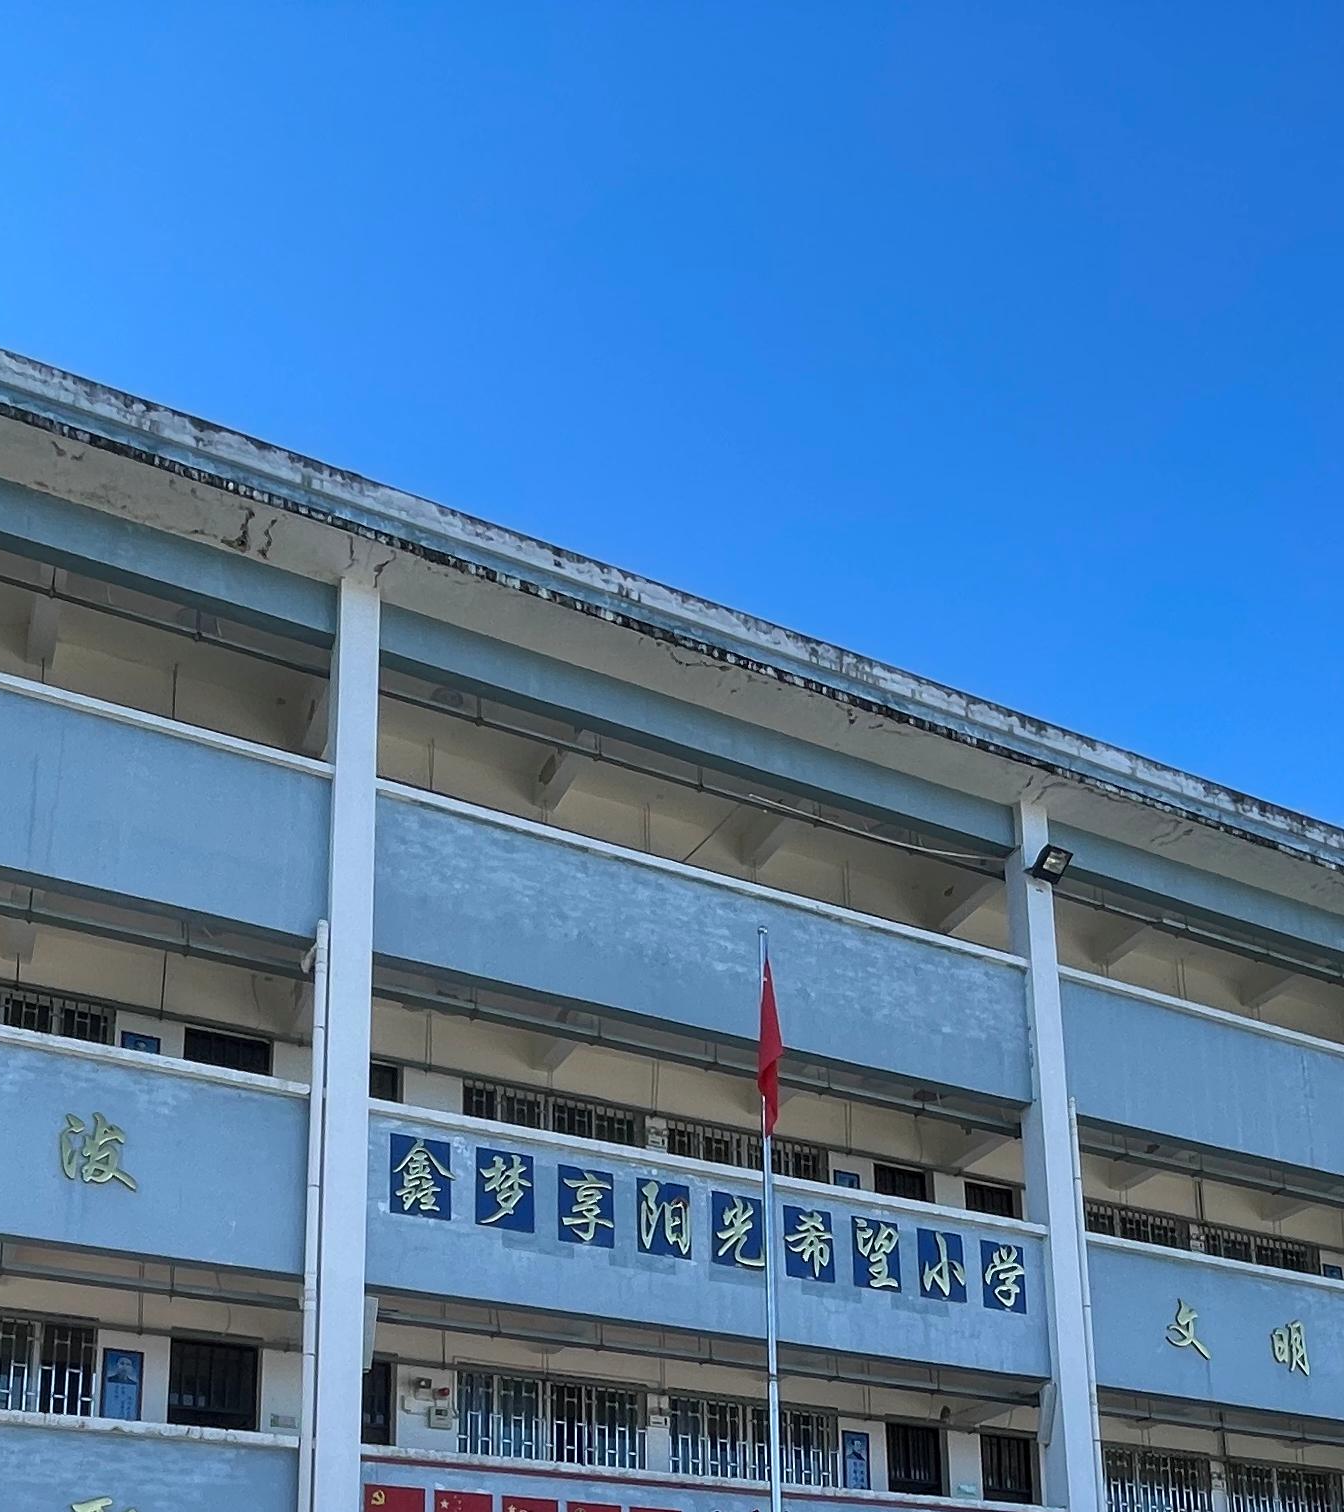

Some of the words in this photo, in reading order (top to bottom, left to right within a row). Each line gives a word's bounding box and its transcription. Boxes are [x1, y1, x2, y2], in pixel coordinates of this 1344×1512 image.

[392, 1137, 1026, 1309] 鑫梦享阳光希望小学
